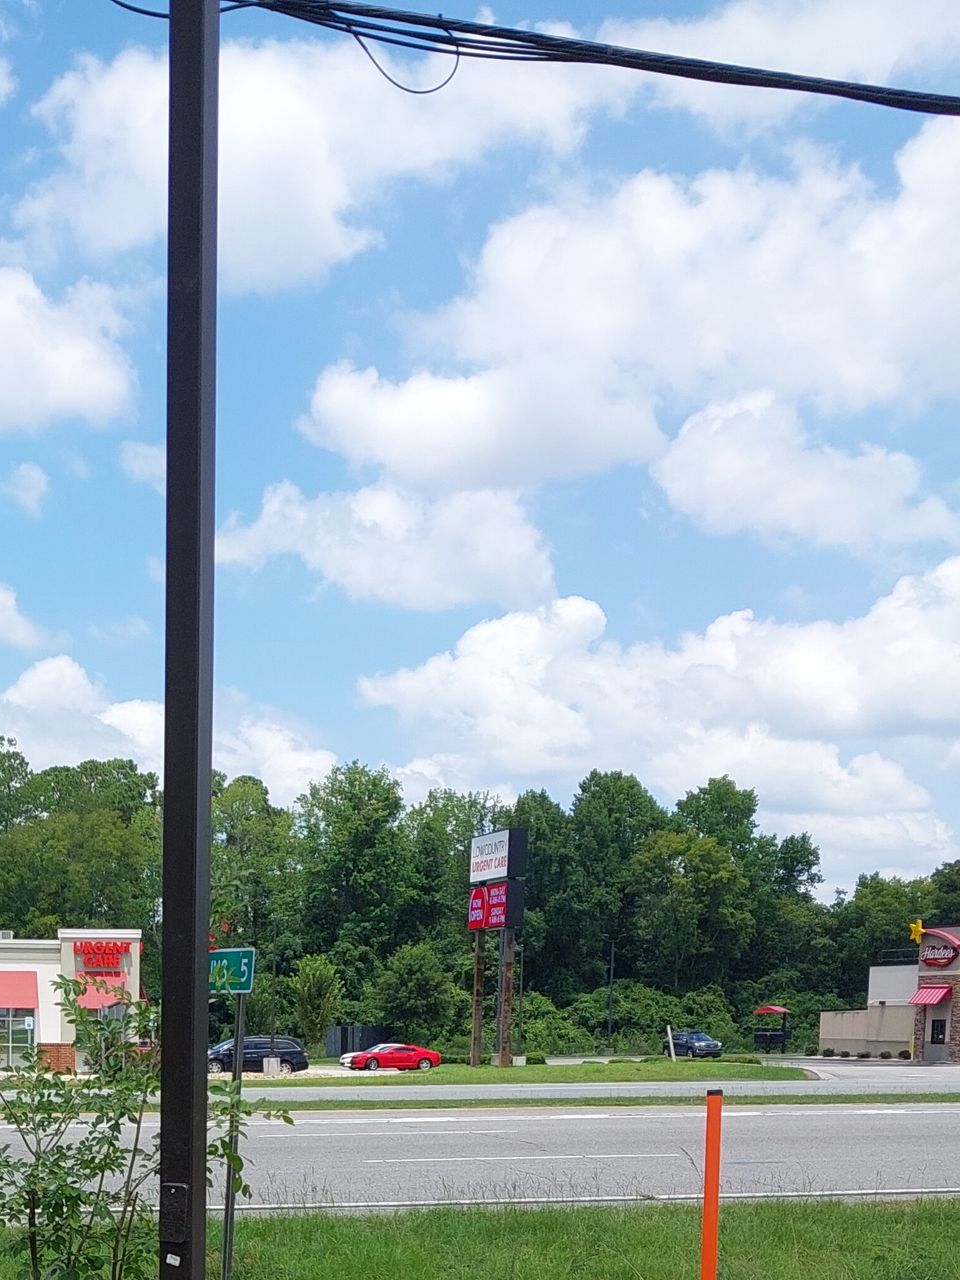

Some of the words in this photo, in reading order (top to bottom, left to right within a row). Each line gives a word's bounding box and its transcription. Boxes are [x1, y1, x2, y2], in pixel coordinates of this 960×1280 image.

[472, 858, 493, 873] URGENT
[494, 855, 507, 869] CARE
[471, 909, 483, 921] OPEN
[73, 941, 132, 955] URGENT
[83, 954, 120, 967] CARE
[241, 958, 249, 982] 5
